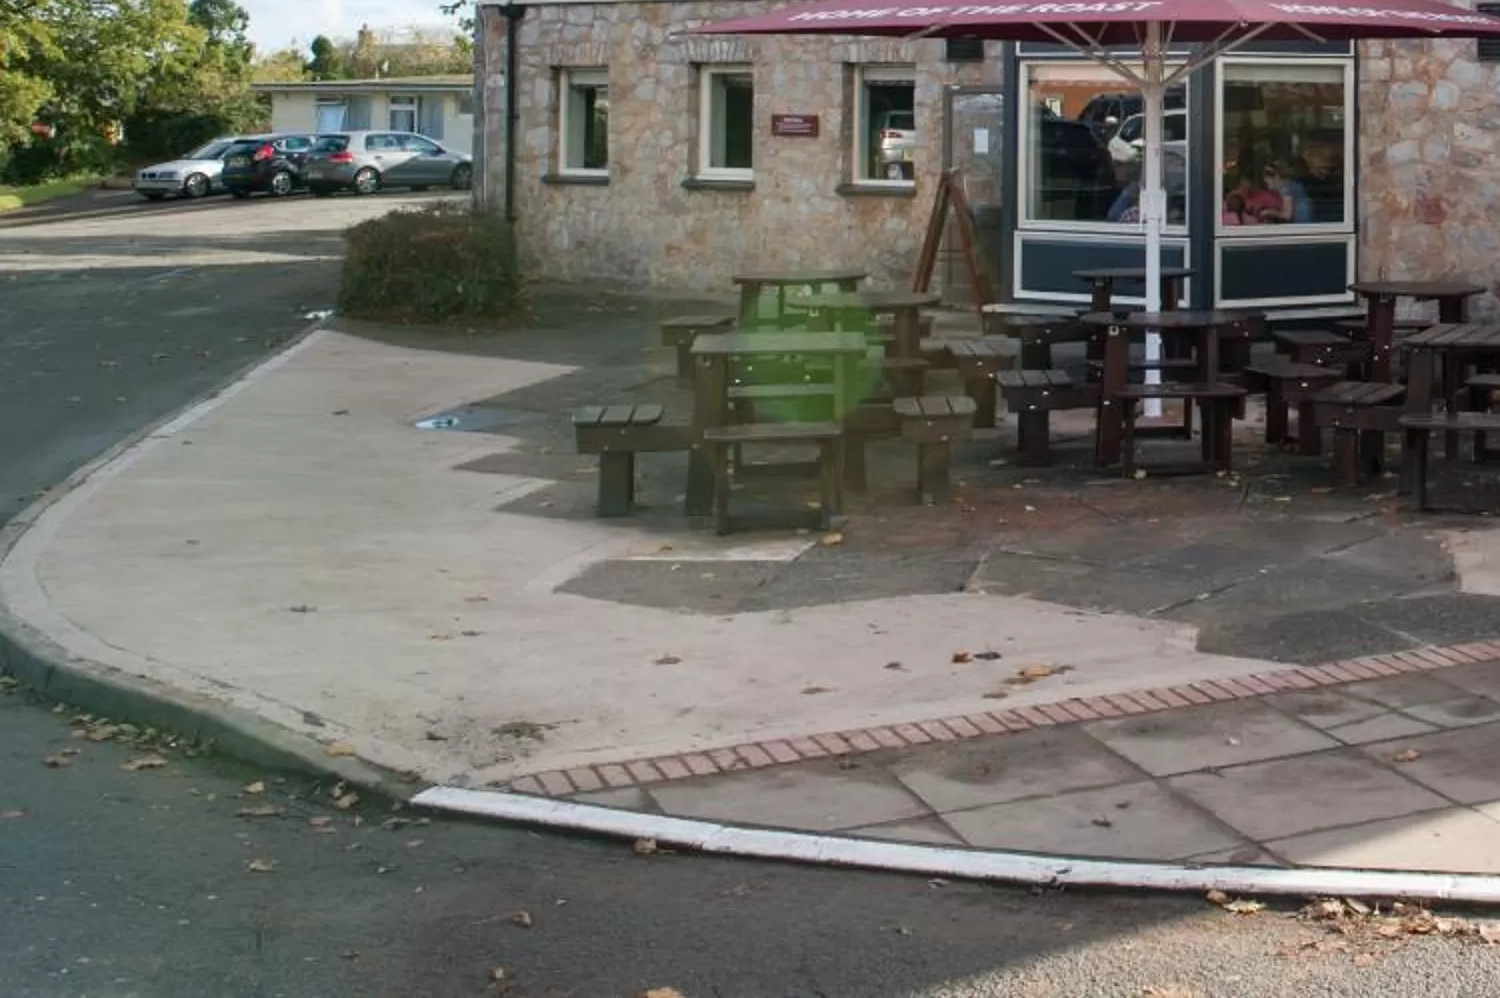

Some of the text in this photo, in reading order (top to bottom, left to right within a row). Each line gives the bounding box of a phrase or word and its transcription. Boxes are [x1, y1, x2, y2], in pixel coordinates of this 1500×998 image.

[787, 1, 1163, 22] HOME OF THE ROAST
